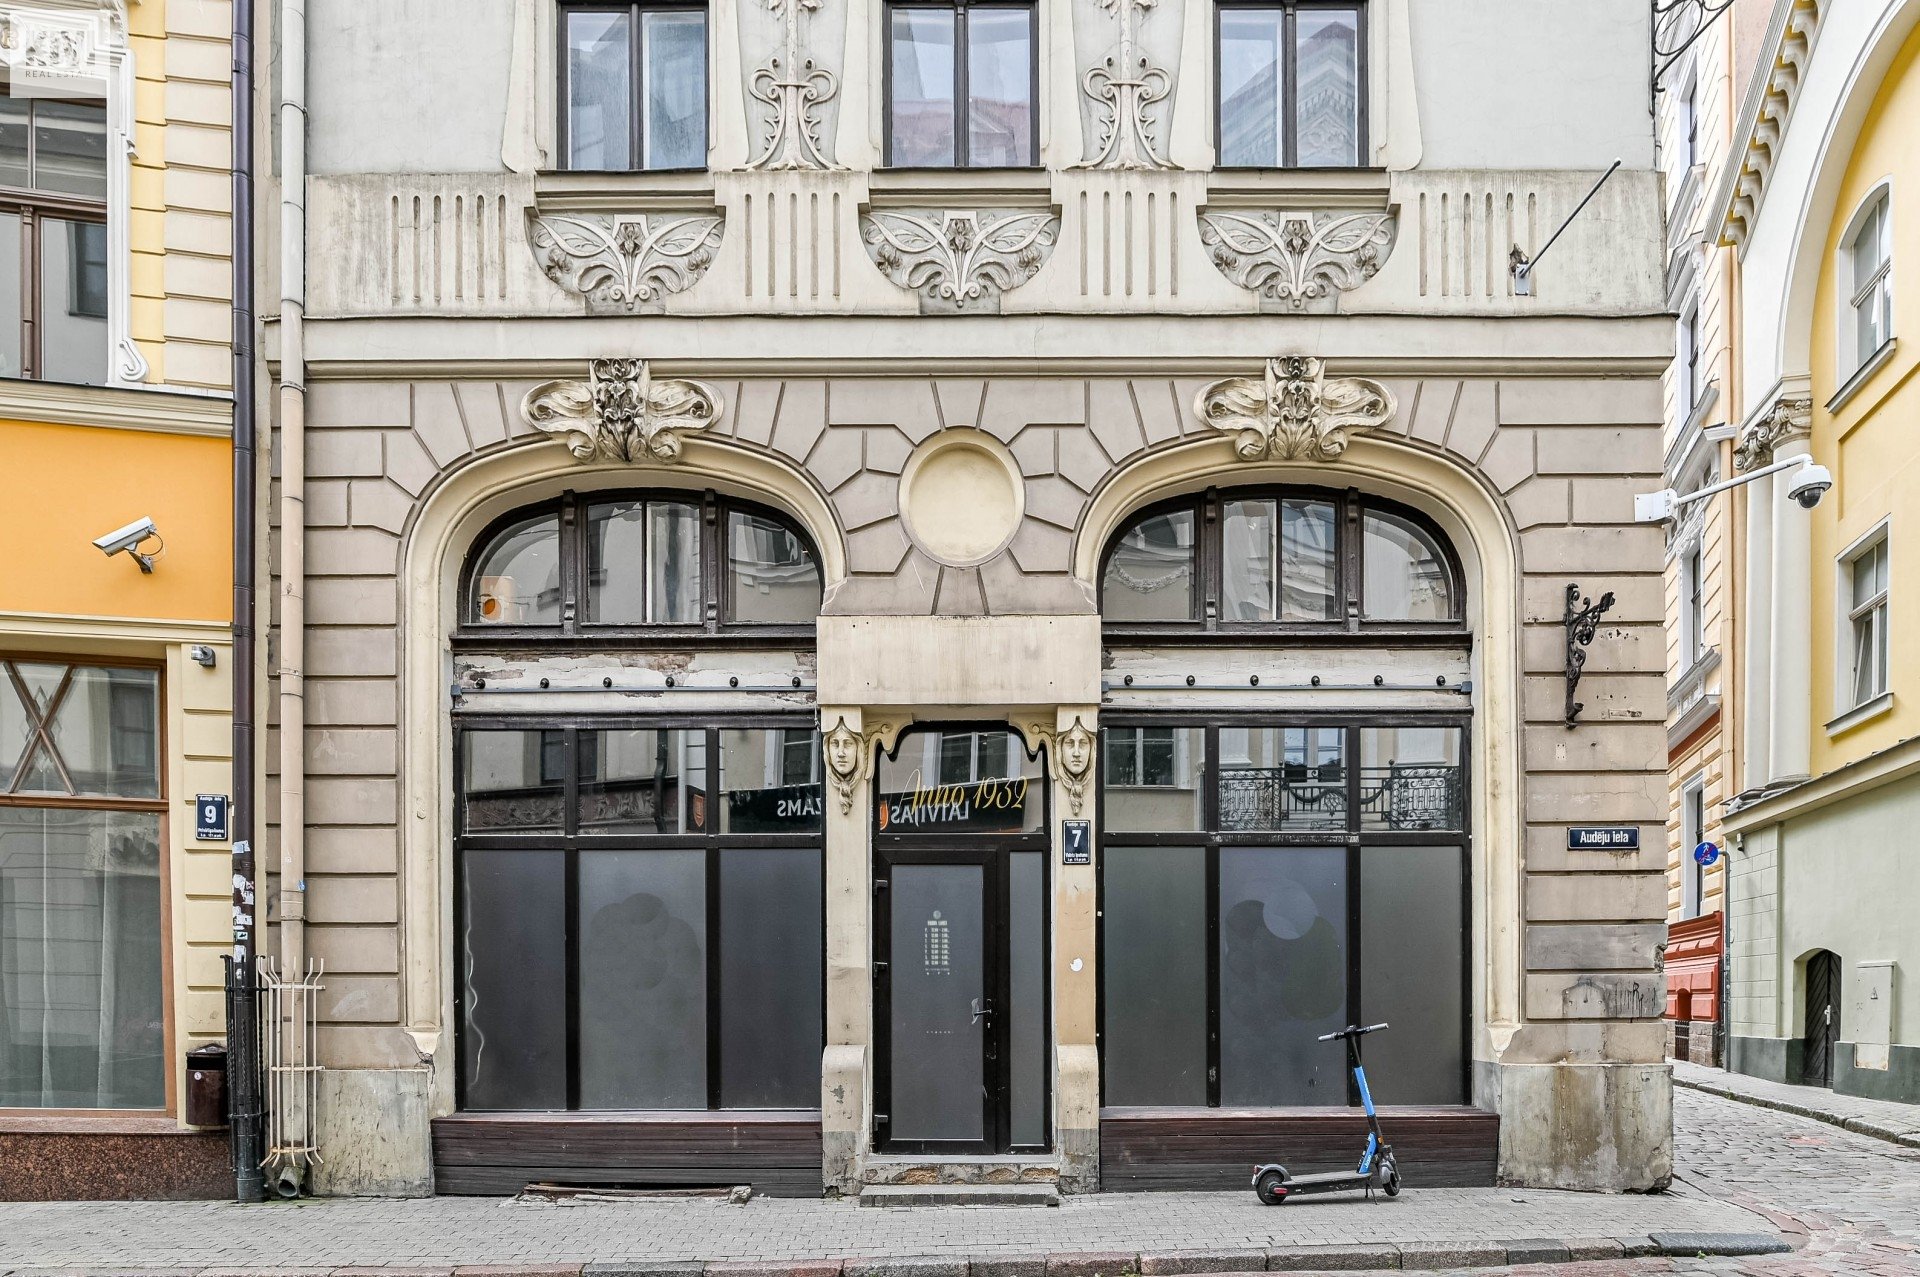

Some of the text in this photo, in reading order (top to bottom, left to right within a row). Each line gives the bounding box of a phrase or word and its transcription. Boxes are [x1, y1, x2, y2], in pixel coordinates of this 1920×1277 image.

[899, 769, 1029, 815] Anno 1932
[205, 805, 216, 823] 9
[1071, 829, 1082, 848] 7
[1580, 831, 1629, 845] Audēju iela
